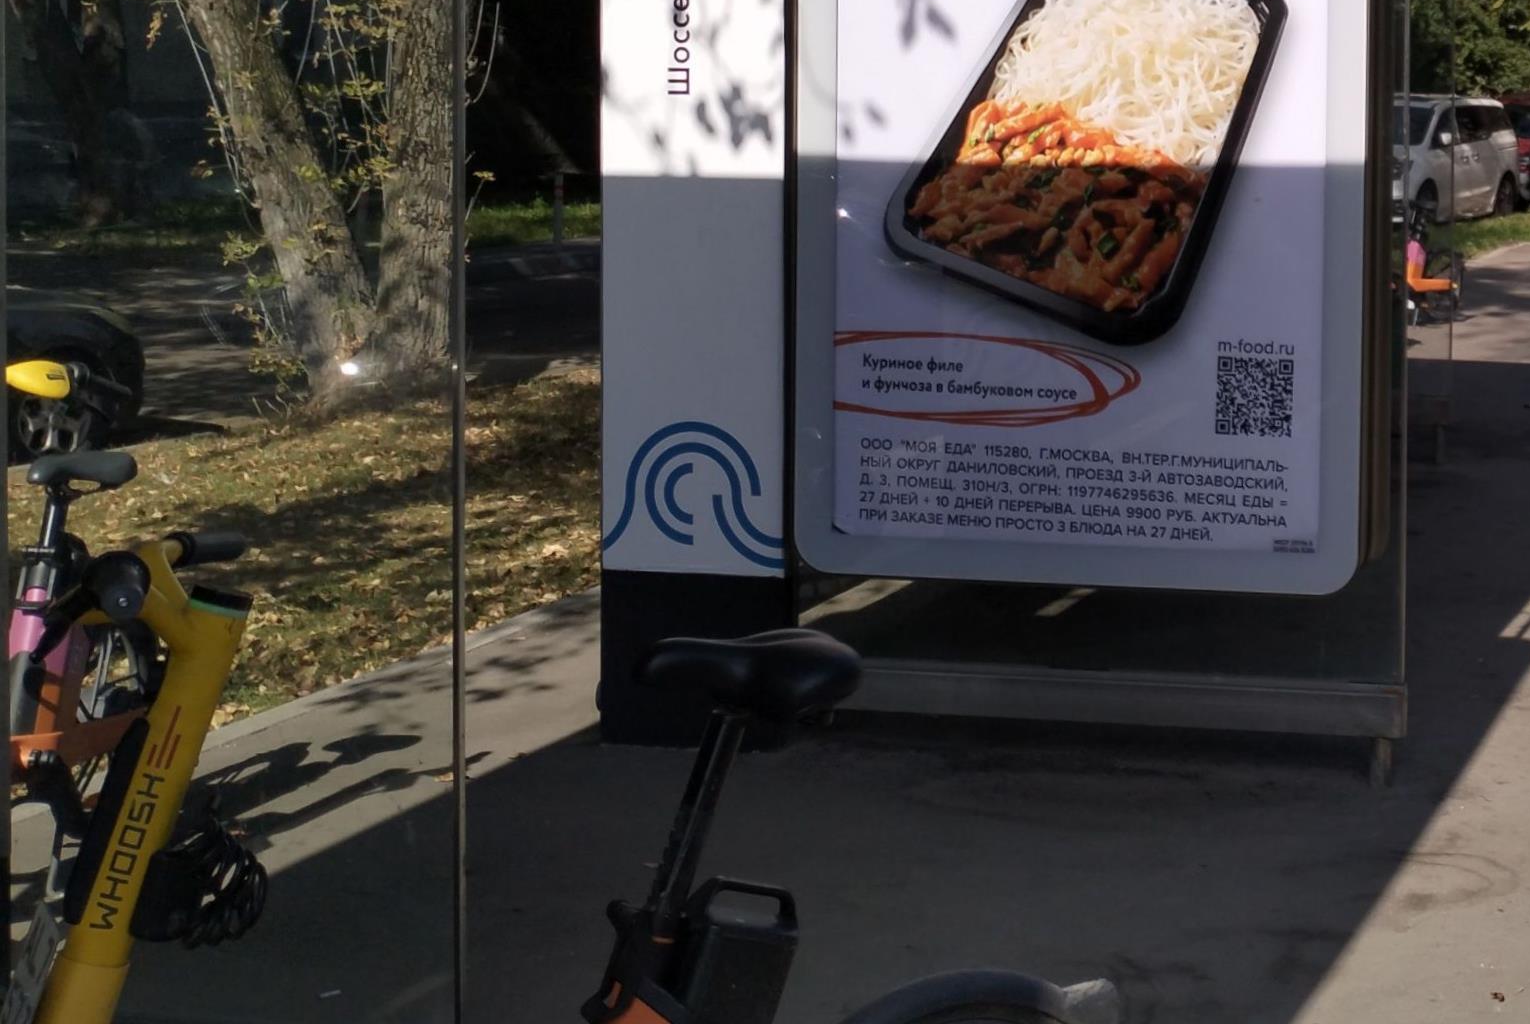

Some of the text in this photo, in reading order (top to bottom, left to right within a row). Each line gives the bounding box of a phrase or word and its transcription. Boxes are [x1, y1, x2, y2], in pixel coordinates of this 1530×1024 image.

[862, 353, 963, 373] Куриное филе
[1218, 338, 1294, 355] m-food.ru
[862, 377, 1077, 402] и фунчоза в бамбуковом соусе
[860, 437, 893, 450] ООО
[900, 439, 936, 453] "МОЯ
[944, 442, 976, 456] ЕДА"
[1040, 447, 1114, 464] Г.МОСКВА,
[859, 473, 873, 486] Д.
[962, 479, 1012, 494] 310Н/3,
[1019, 482, 1061, 497] ОГРН:
[1184, 492, 1236, 507] МЕСЯЦ
[1242, 495, 1274, 508] ЕДЫ
[860, 455, 1288, 492] НЫЙ ОКРУГ ДАНИЛОВСКИЙ, ПРОЕЗД 3-Й АВТОЗАВОДСКИЙ,
[859, 490, 1287, 528] 27 ДНЕЙ + 10 ДНЕЙ ПЕРЕРЫВА. ЦЕНА 9900 РУБ. АКТУАЛЬНА
[859, 508, 1213, 542] ПРИ ЗАКАЗЕ МЕНЮ ПРОСТО 3 БЛЮДА НА 27 ДНЕЙ.
[89, 773, 166, 930] WHOOSH
